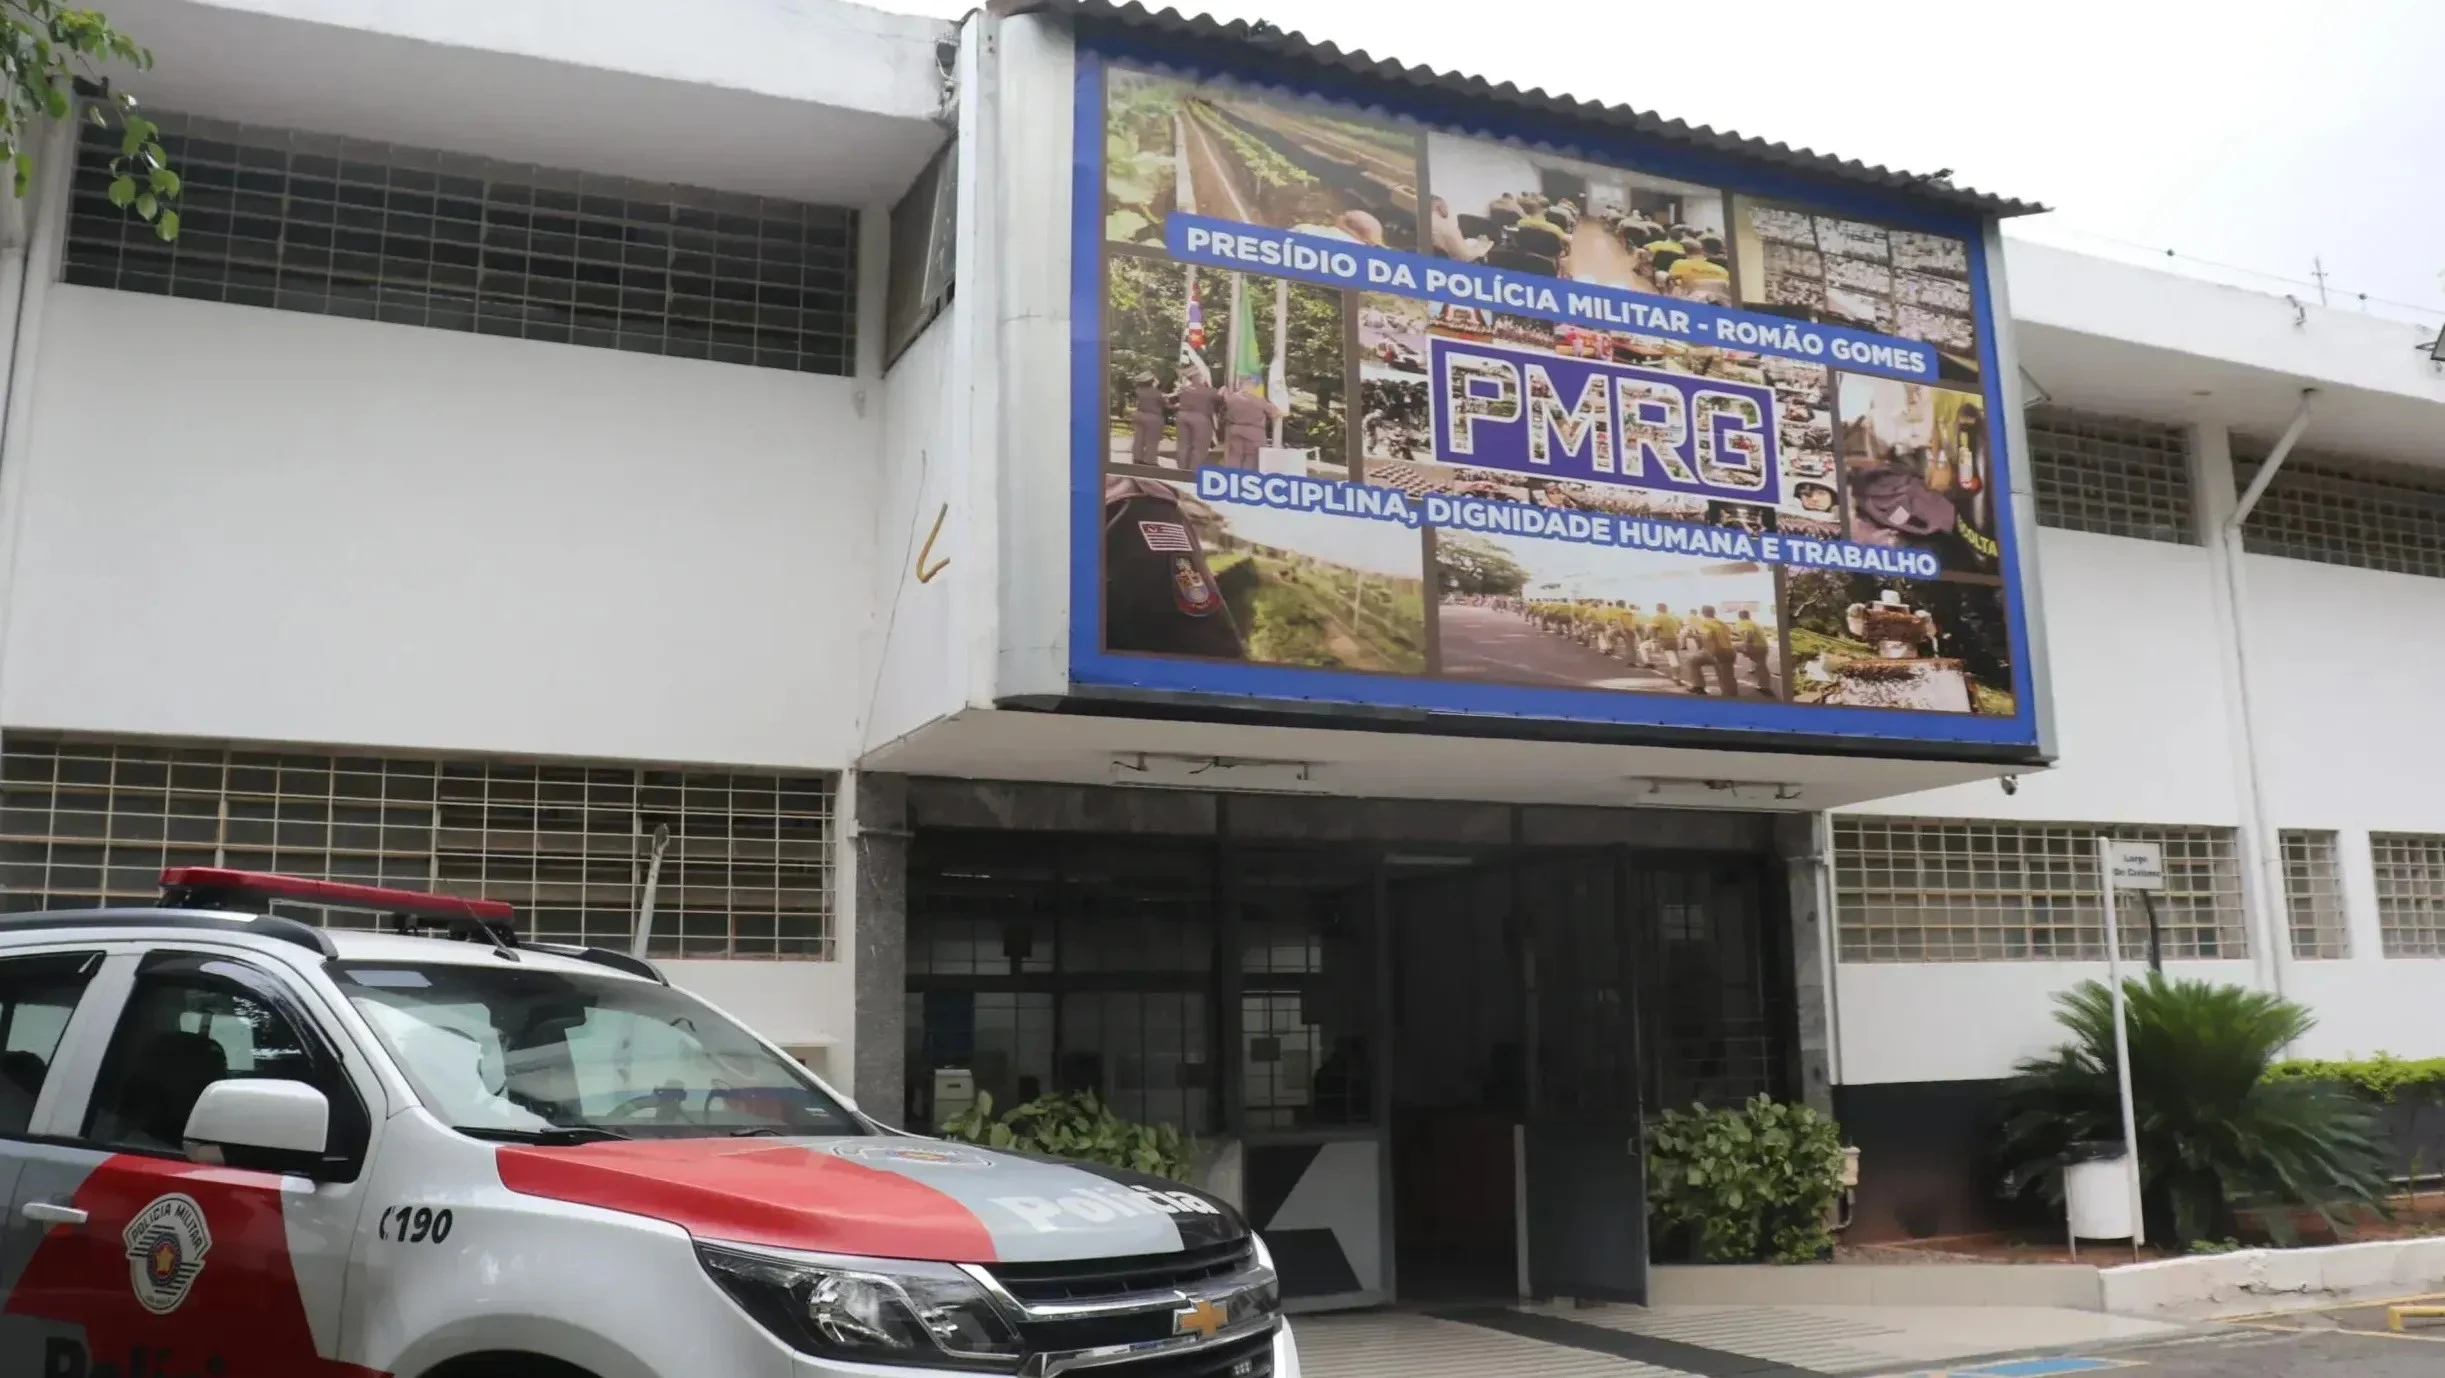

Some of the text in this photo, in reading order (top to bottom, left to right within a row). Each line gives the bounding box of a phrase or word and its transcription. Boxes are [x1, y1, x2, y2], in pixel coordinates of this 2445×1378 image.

[1187, 228, 1357, 278] PRESÍDIO
[1367, 258, 1417, 290] DA
[1427, 266, 1560, 315] POLÍCIA
[1568, 293, 1690, 334] MILITAR
[1716, 316, 1824, 356] ROMÃO
[1831, 339, 1926, 374] GOMES
[1445, 351, 1767, 491] PMRG
[1202, 470, 1938, 577] DISCIPLINA, DIGNIDADE HUMANA E TRABALHO
[174, 1204, 203, 1251] MILITAR
[396, 1206, 453, 1245] 190
